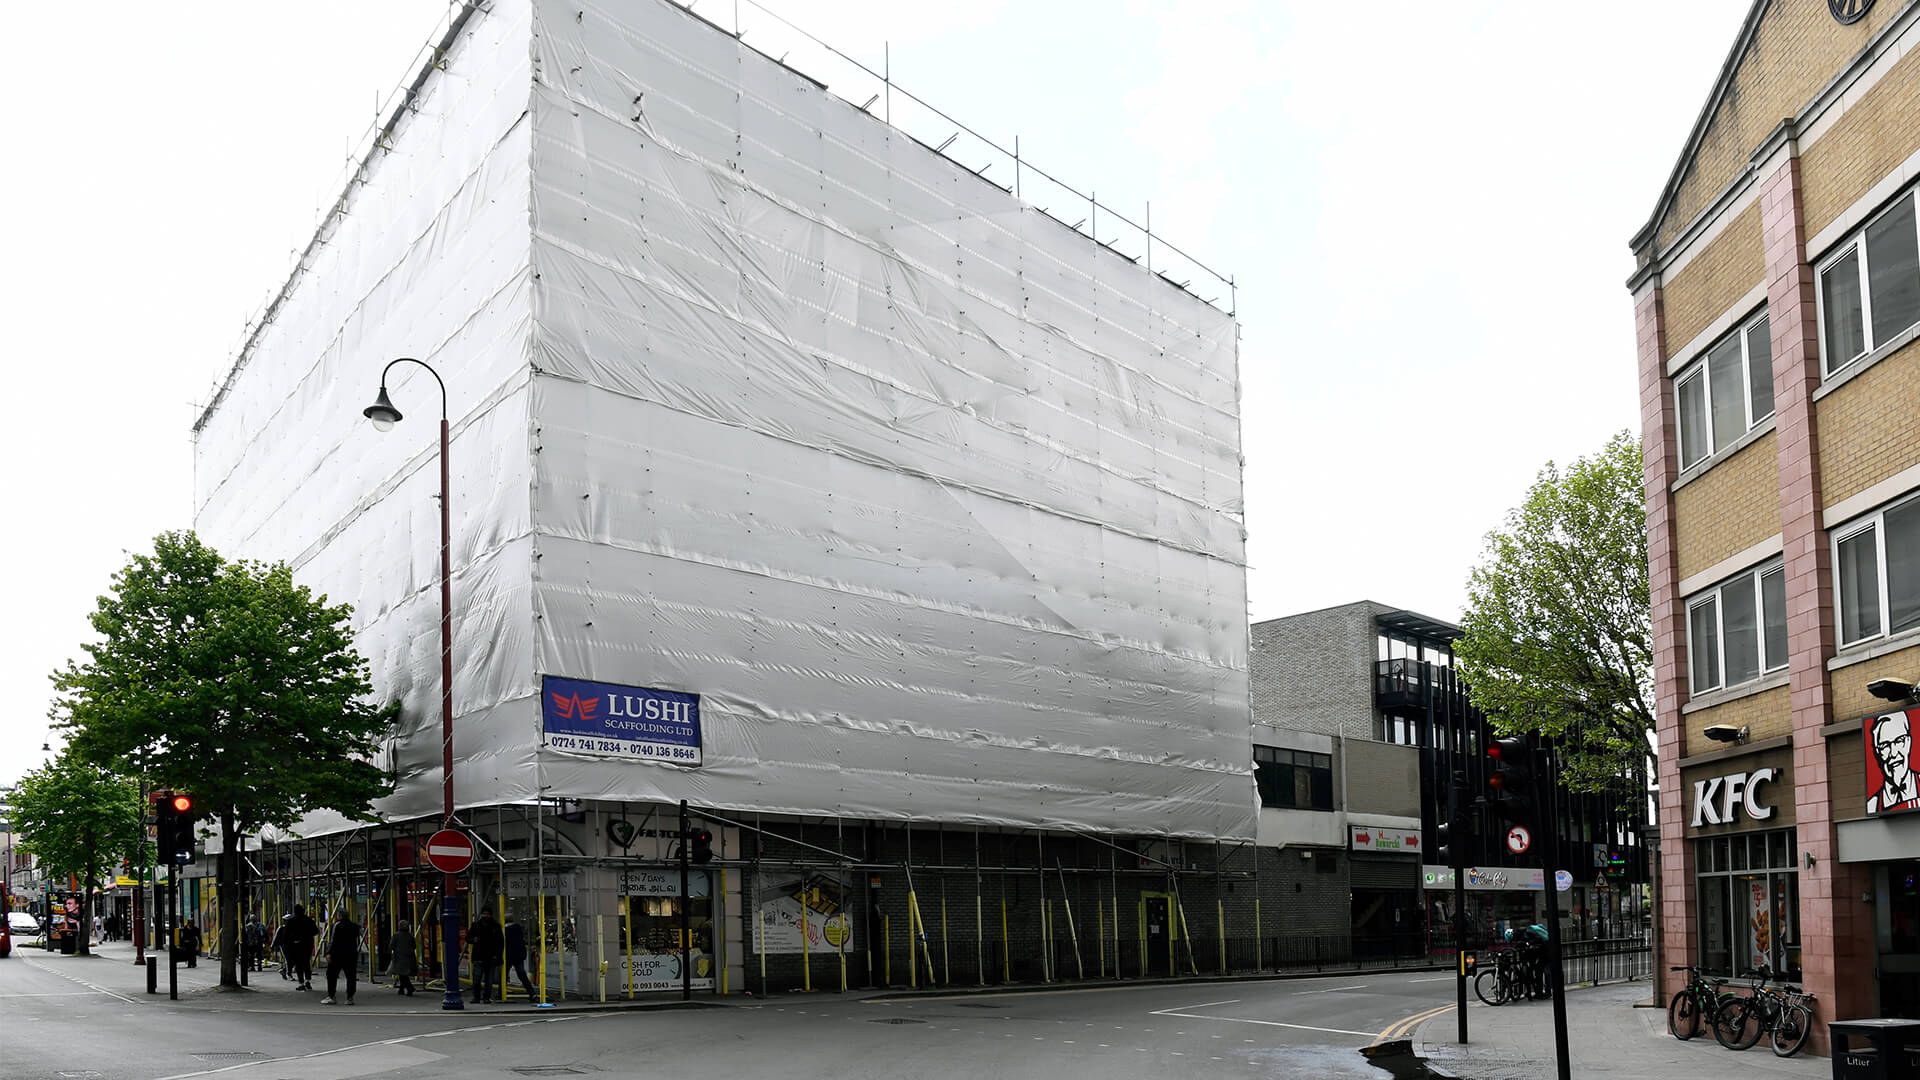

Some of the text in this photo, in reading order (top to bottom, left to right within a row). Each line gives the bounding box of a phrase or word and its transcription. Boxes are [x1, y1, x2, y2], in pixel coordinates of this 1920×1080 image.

[607, 694, 691, 723] LUSHI
[605, 719, 694, 736] SCAFFOLDING LTD
[552, 736, 576, 748] 0774
[578, 738, 595, 751] 741
[597, 741, 621, 753] 7834
[630, 744, 653, 755] 0740
[655, 746, 671, 757] 136
[673, 748, 695, 759] 8646
[1690, 768, 1773, 827] KFC
[641, 873, 647, 882] 7
[647, 874, 665, 883] DAYS
[621, 961, 661, 969] CSH FOR
[1846, 1056, 1870, 1067] Litter
